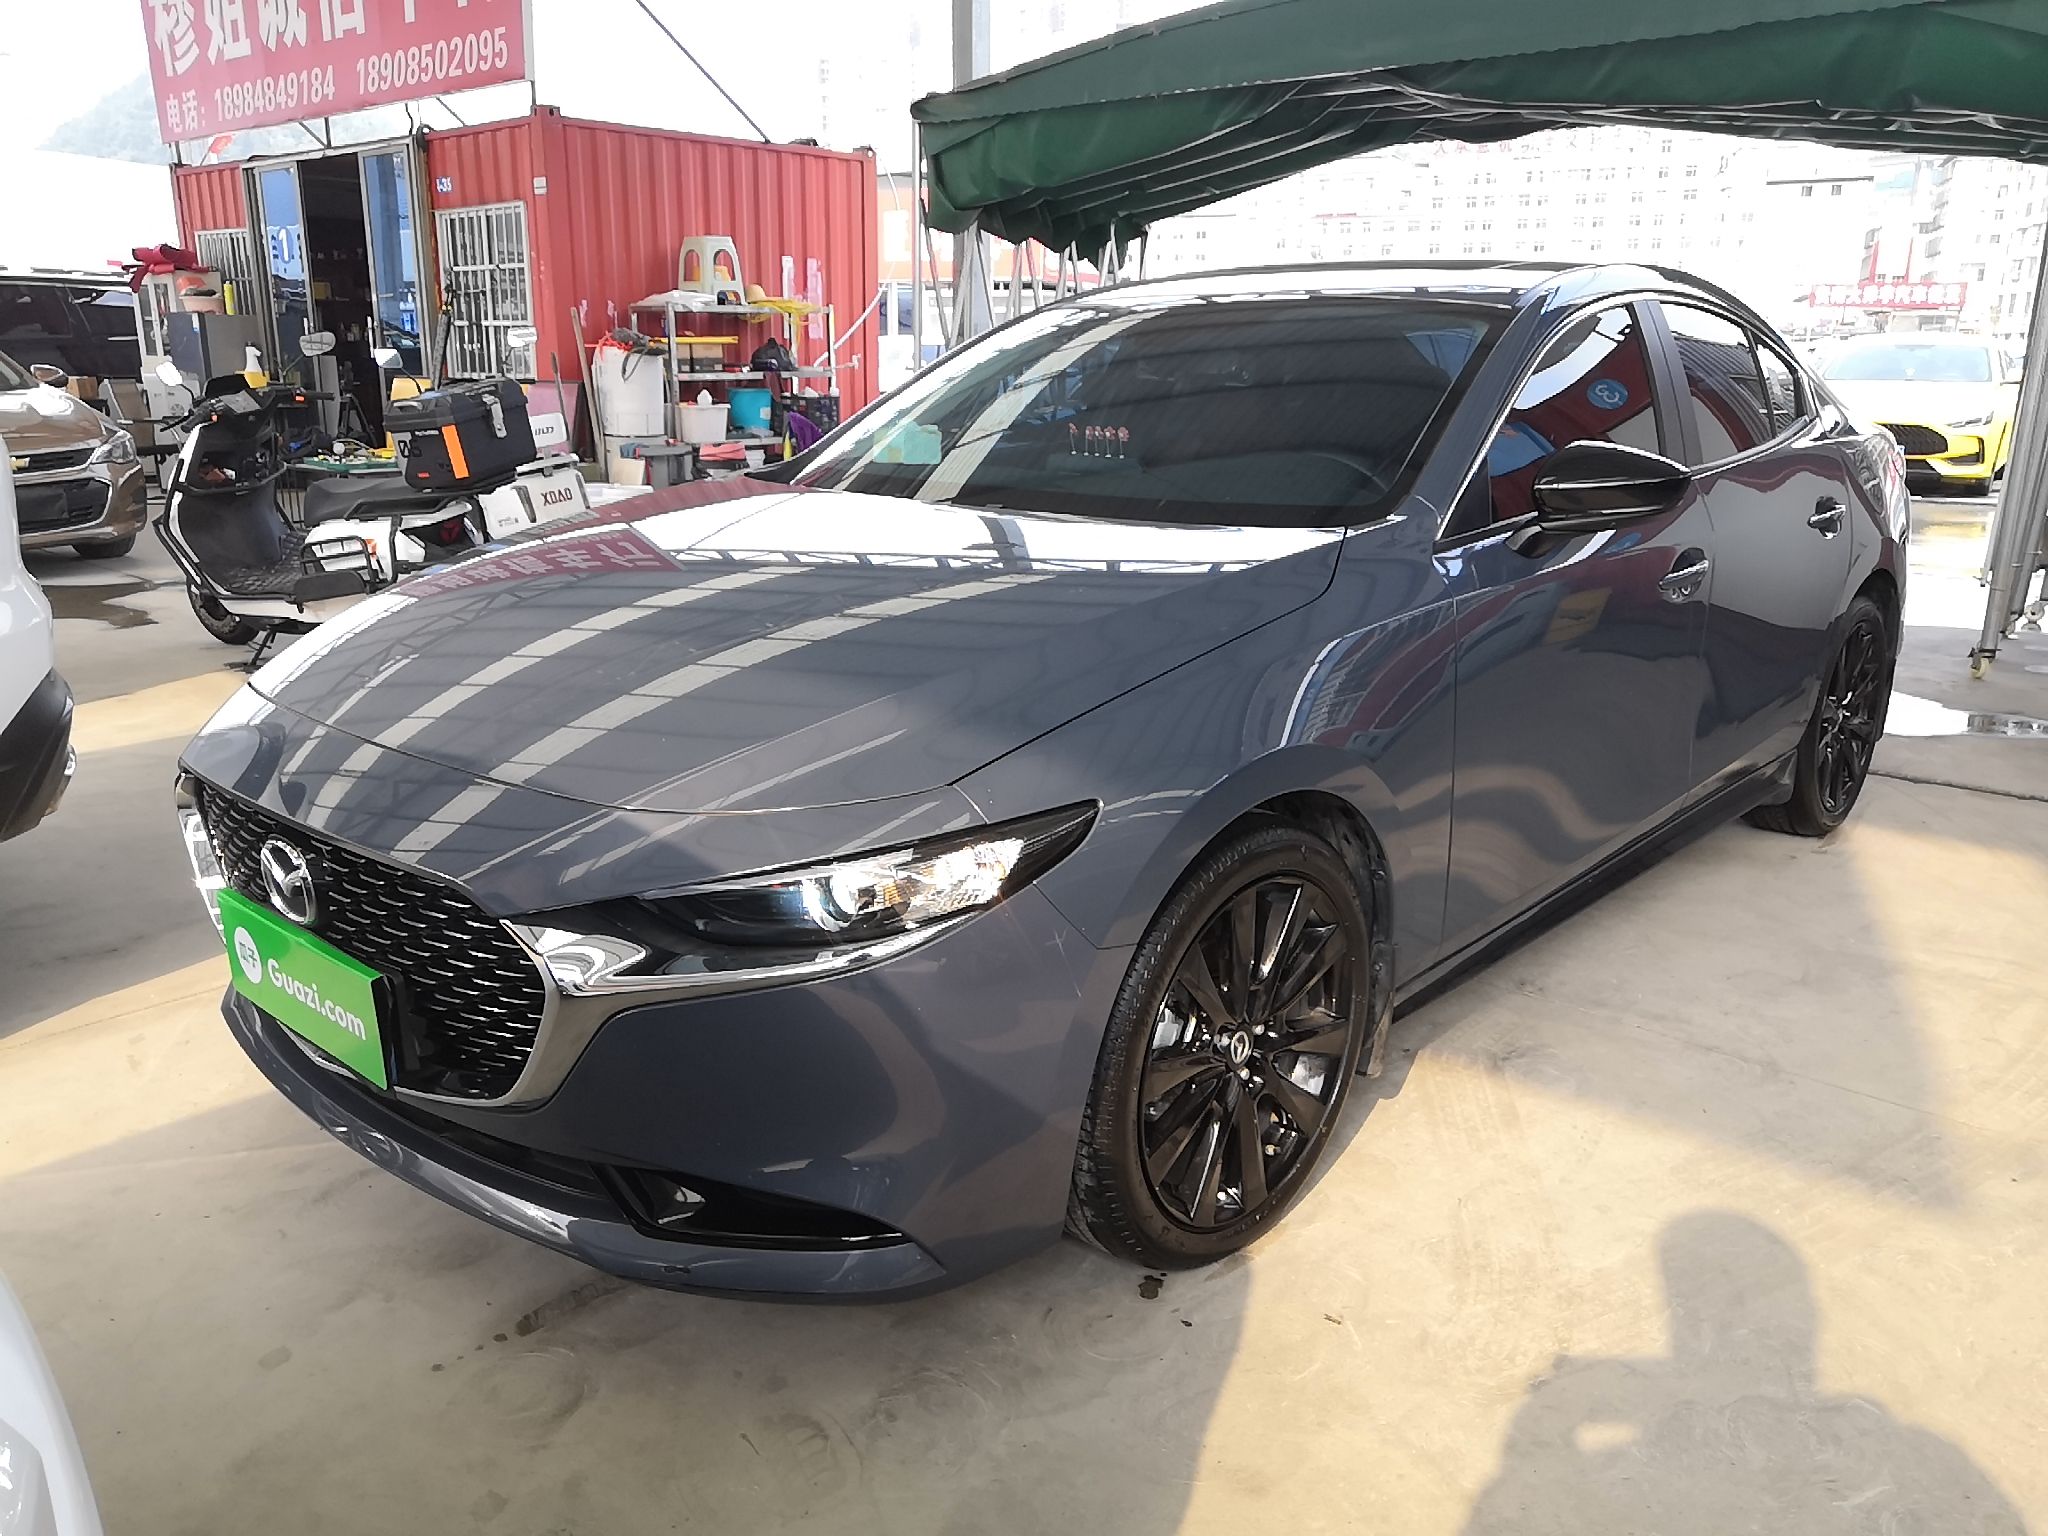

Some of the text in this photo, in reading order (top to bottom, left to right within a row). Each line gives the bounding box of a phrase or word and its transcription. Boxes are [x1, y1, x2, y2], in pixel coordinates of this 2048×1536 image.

[148, 0, 492, 77] 穆姐诚
[214, 65, 335, 122] 18984849184
[356, 26, 508, 95] 18908502095
[267, 958, 366, 1041] Guazi.com
